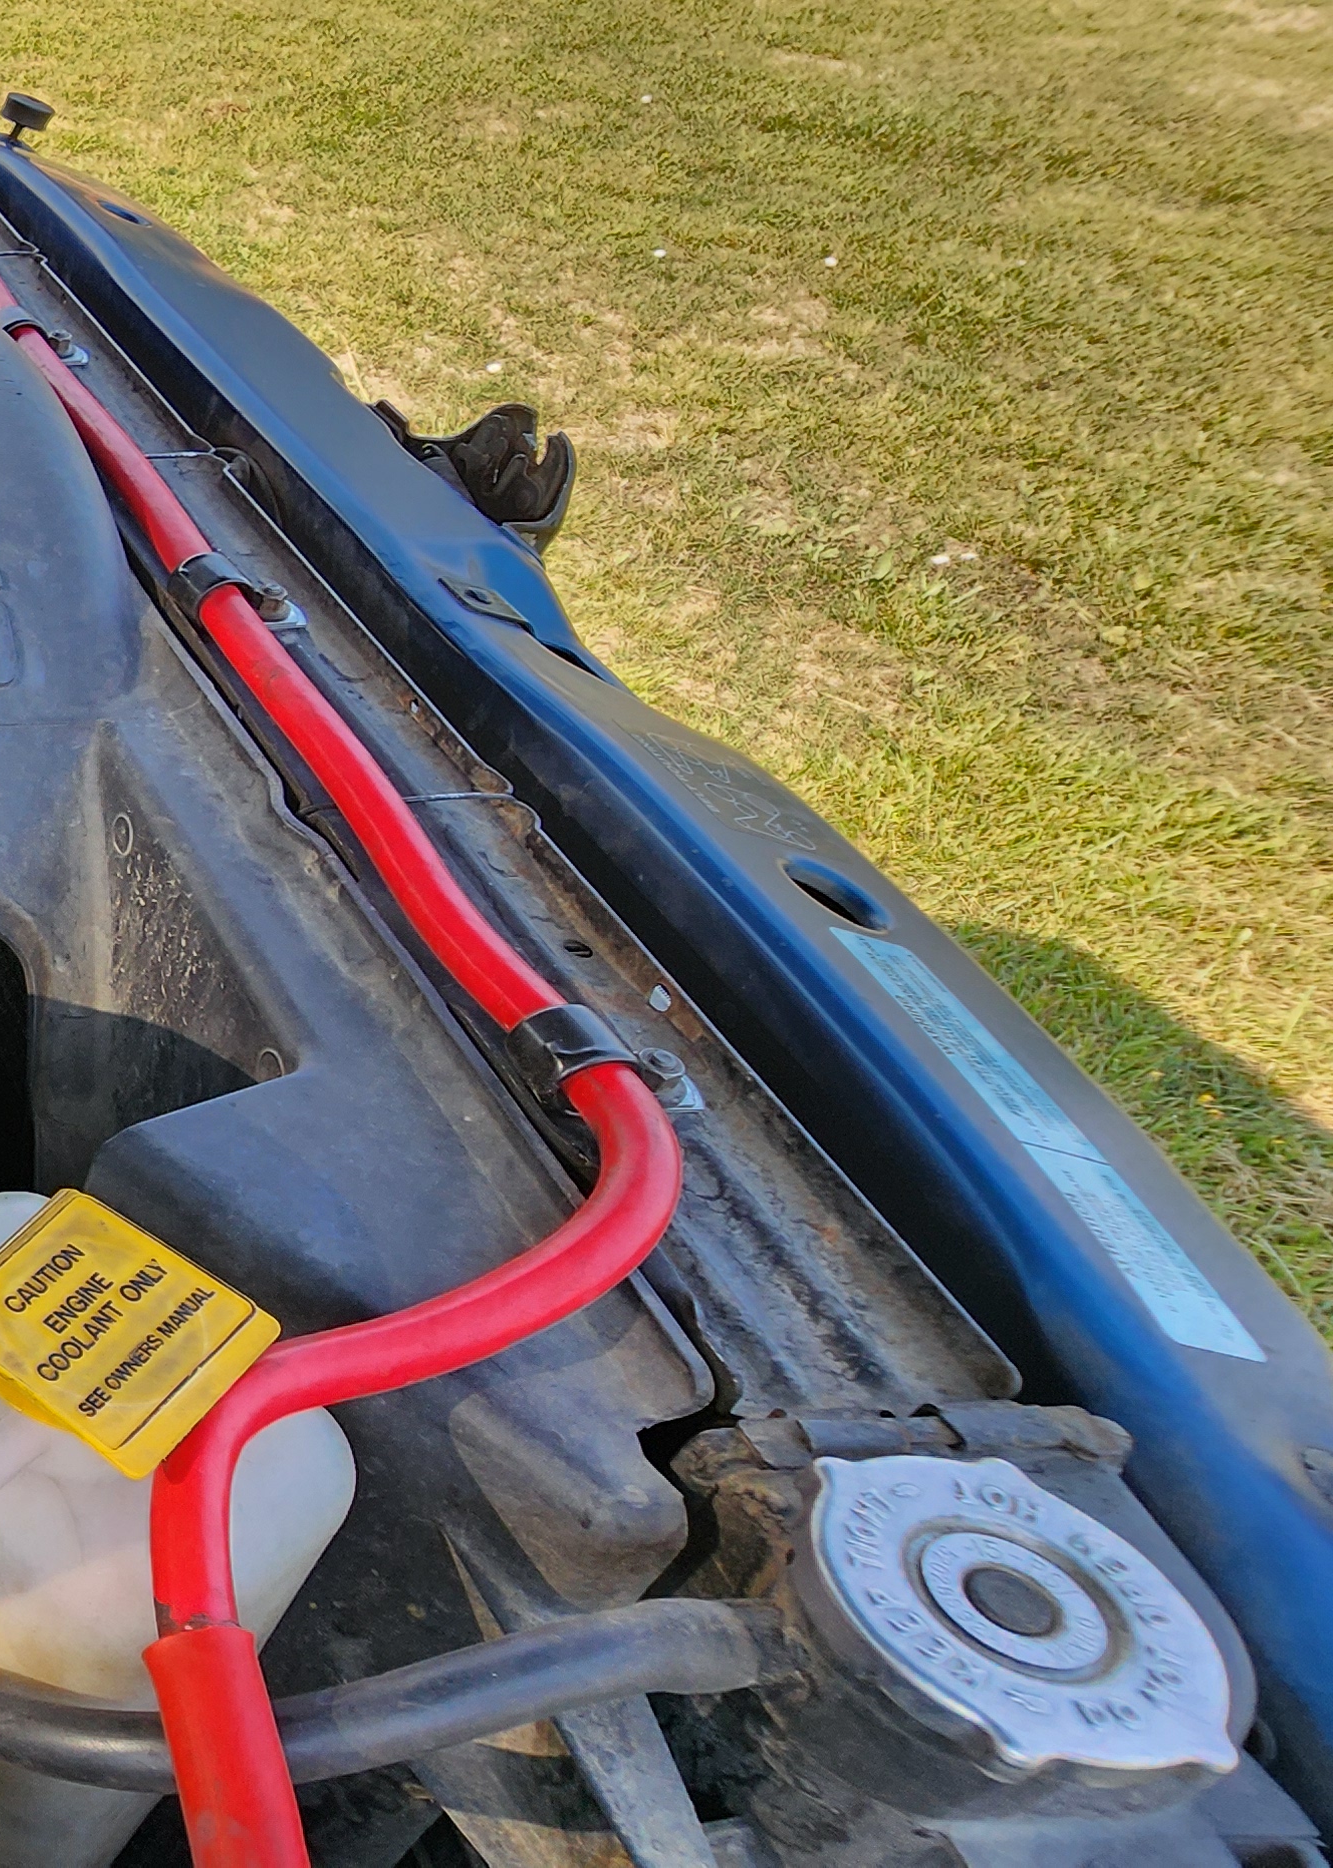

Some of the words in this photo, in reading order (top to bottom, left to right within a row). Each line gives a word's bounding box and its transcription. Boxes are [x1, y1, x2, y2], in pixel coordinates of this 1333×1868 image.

[3, 1243, 86, 1314] CAUTION
[36, 1299, 124, 1383] COOLANT
[118, 1258, 170, 1304] ONLY
[42, 1271, 114, 1335] ENGINE
[77, 1386, 113, 1418] SEE
[107, 1334, 165, 1391] OWNERS
[156, 1287, 217, 1340] MANUAL
[844, 1486, 896, 1571] TIGHT
[865, 1586, 989, 1690] KEEP
